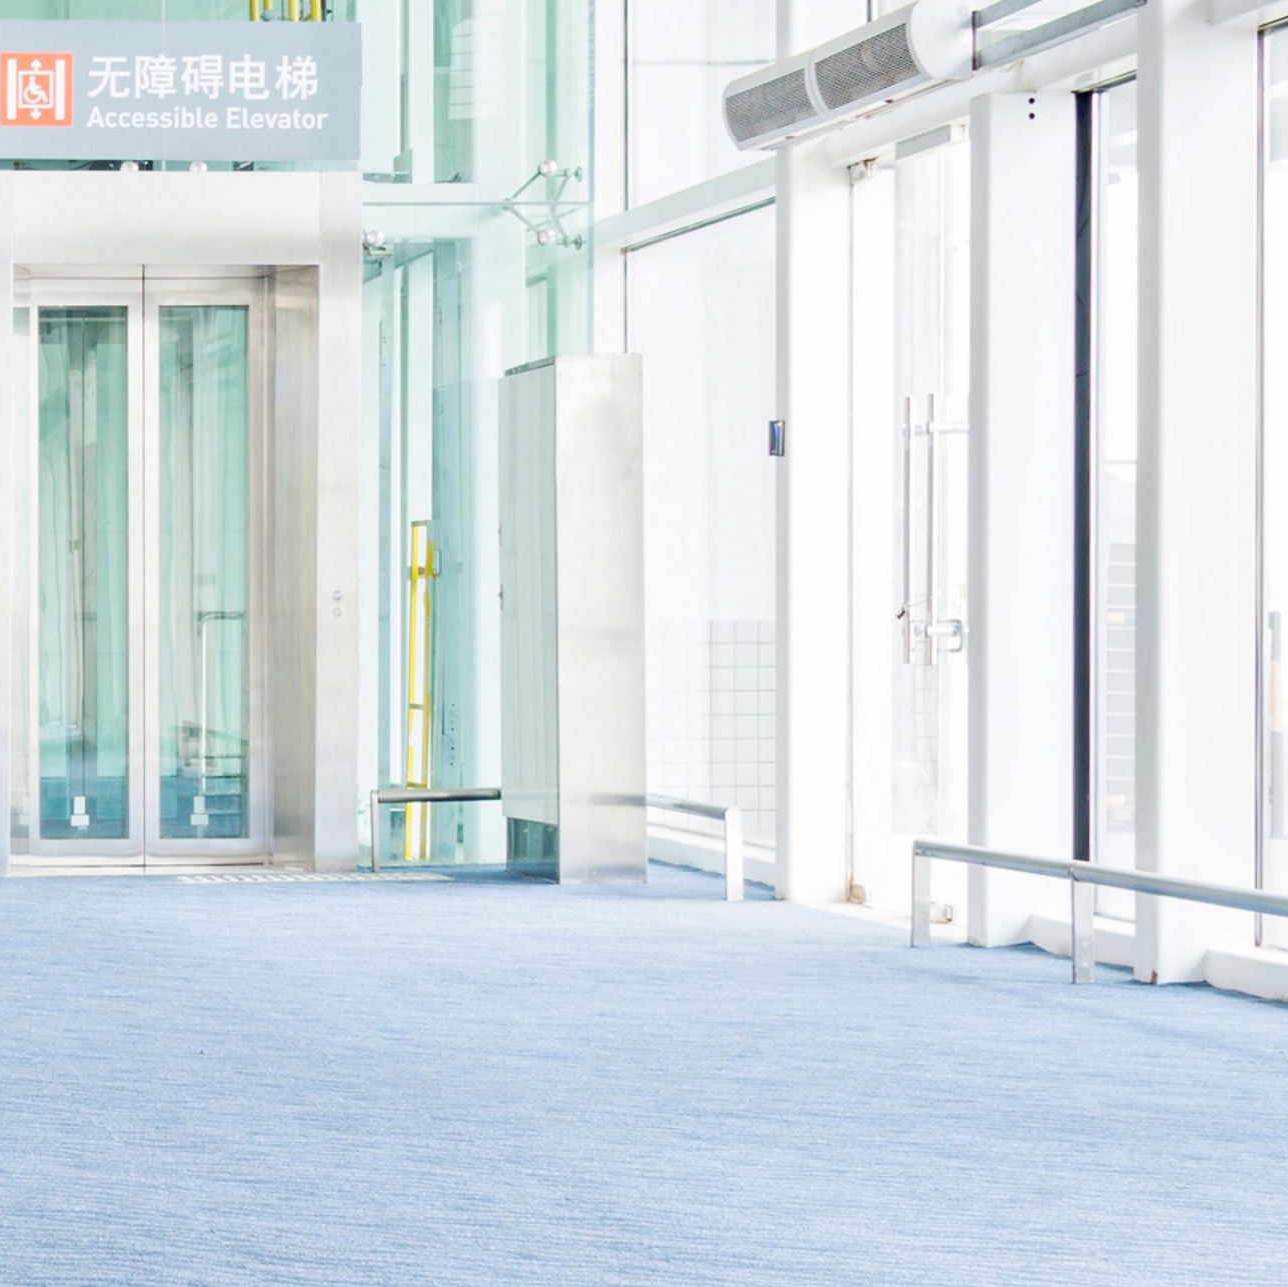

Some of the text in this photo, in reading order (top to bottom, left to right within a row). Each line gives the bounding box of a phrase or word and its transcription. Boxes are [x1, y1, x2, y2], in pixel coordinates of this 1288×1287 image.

[86, 53, 320, 101] 无障碍电梯
[86, 107, 329, 130] Accessible Elevator
